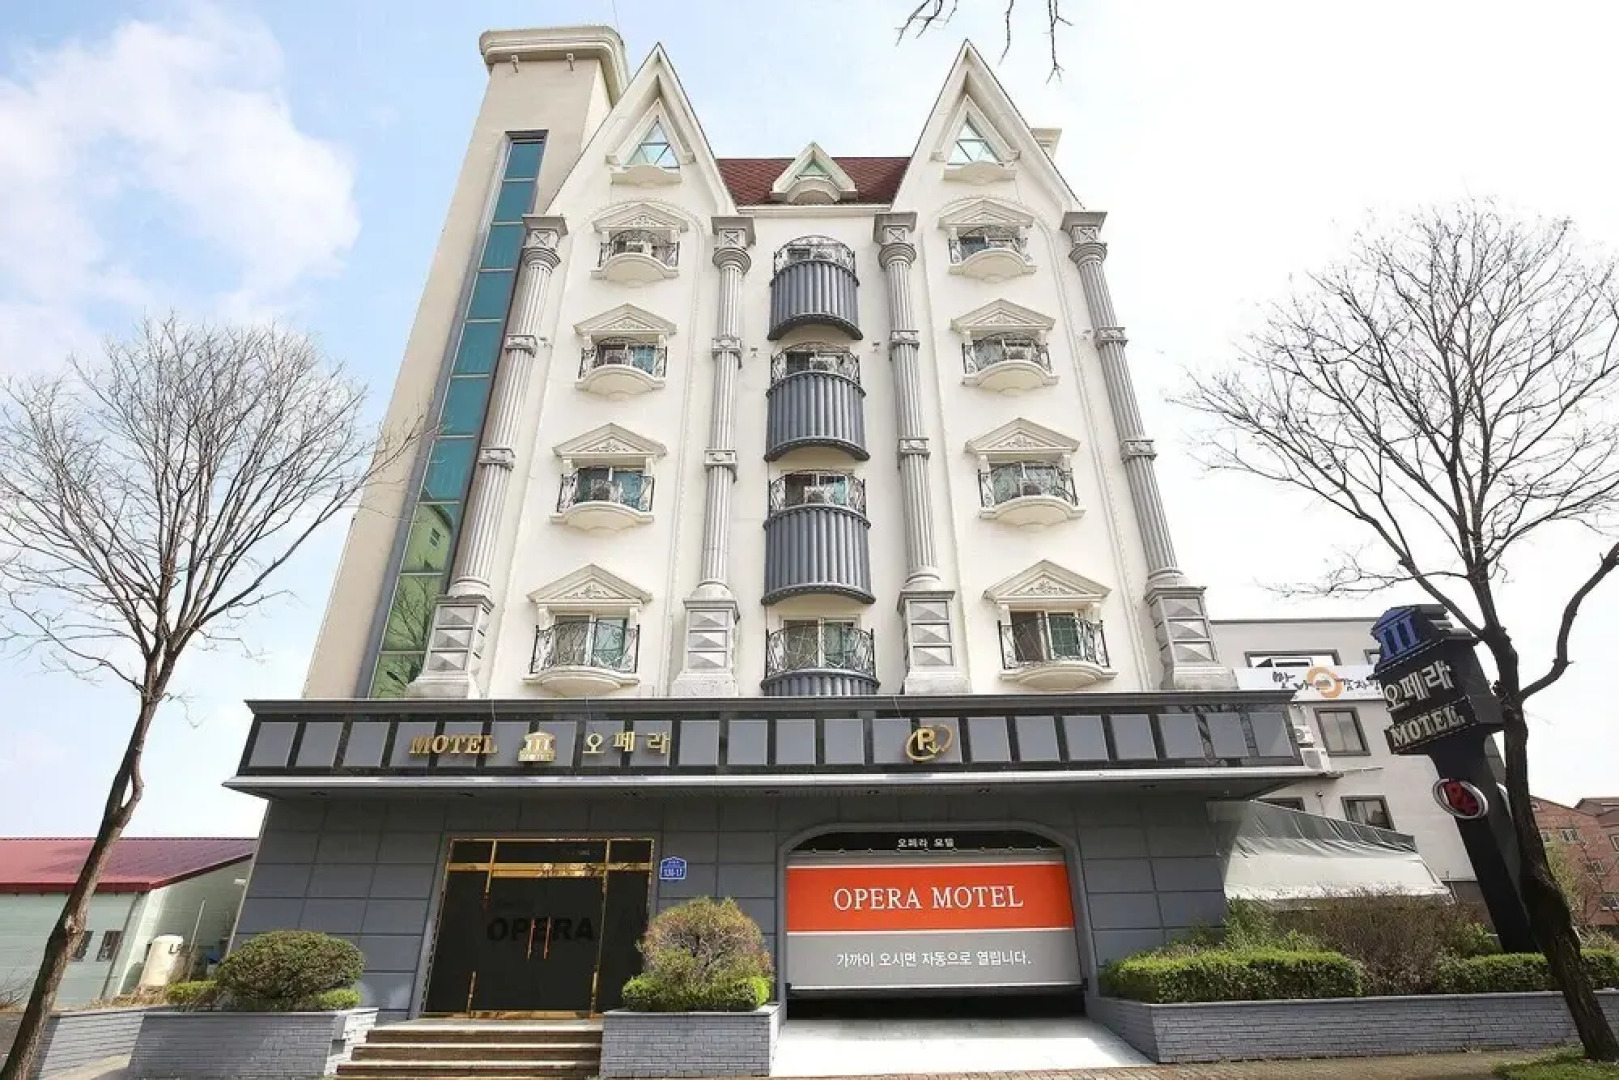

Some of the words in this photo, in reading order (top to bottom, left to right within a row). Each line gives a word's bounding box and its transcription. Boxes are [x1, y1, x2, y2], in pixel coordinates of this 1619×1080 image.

[1384, 660, 1454, 712] 오페라
[1390, 705, 1465, 747] MOTEL
[408, 733, 498, 755] MOTEL
[583, 731, 670, 754] 오페라
[898, 838, 928, 848] 오페라
[833, 887, 922, 911] OPERA
[931, 885, 1024, 909] MOTEL
[486, 916, 595, 942] OPERA
[836, 953, 874, 968] 가까이
[879, 951, 917, 967] 오시면
[921, 951, 972, 967] 자동으로
[977, 950, 1032, 966] 열립니다.
